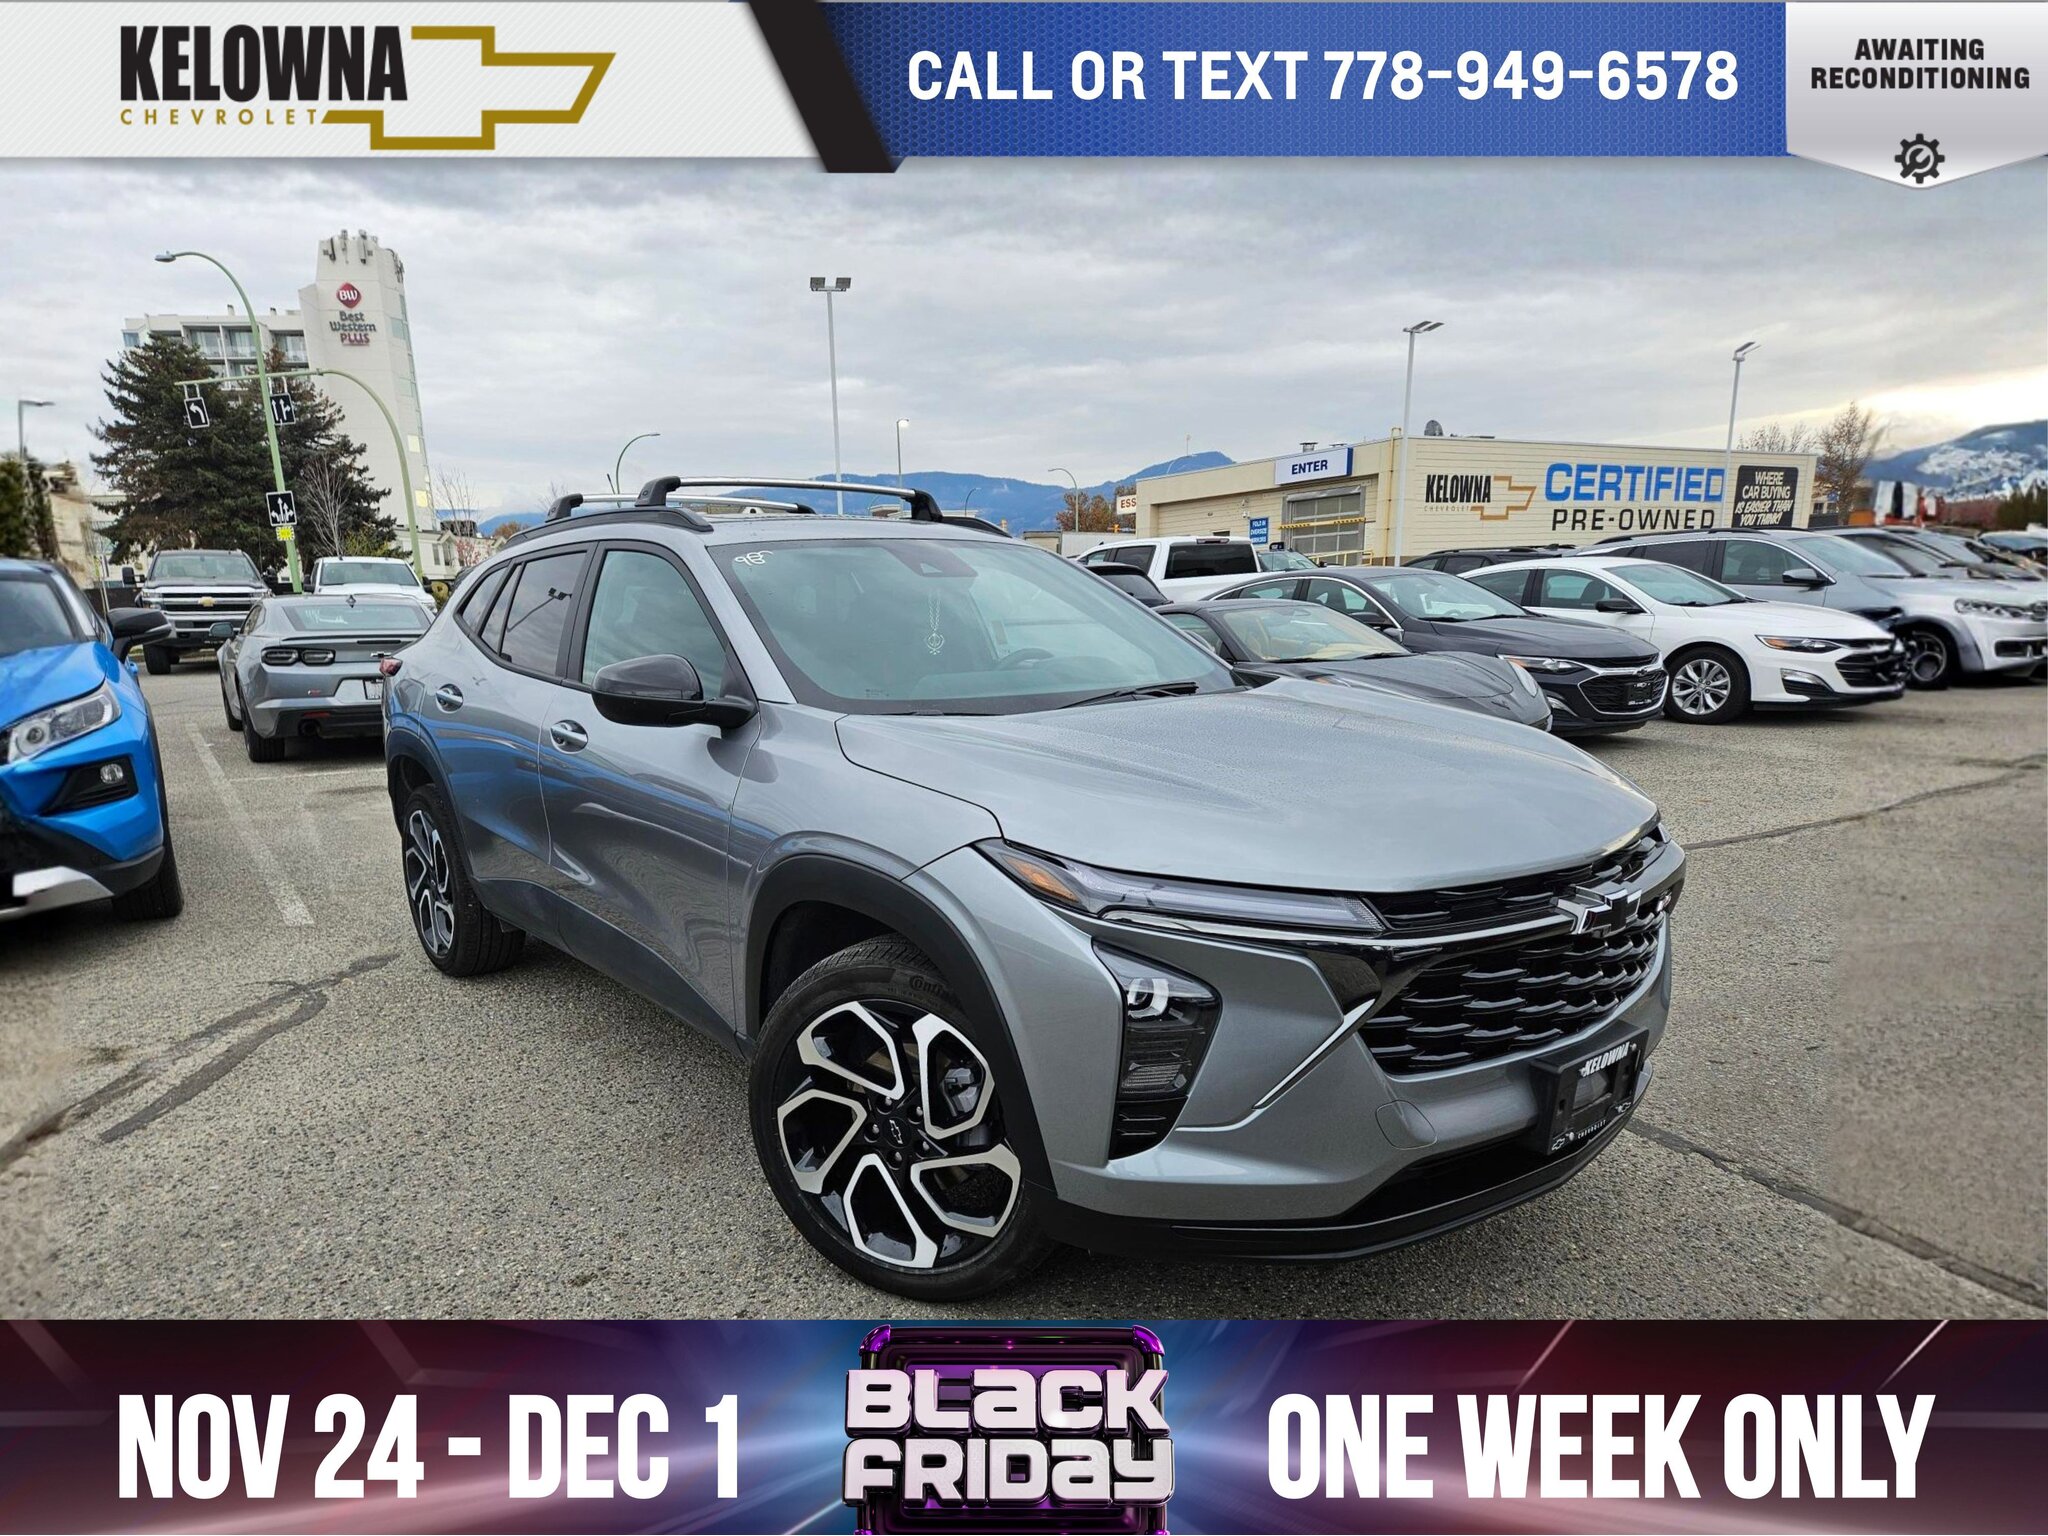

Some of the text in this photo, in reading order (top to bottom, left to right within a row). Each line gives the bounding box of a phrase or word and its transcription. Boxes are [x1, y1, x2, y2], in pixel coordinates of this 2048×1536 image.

[340, 290, 358, 301] BW
[339, 311, 365, 321] Best
[329, 321, 376, 332] Western
[340, 333, 370, 344] PLUS
[1291, 459, 1328, 475] ENTER
[1545, 463, 1725, 502] CERTIFIED
[1755, 471, 1784, 485] WHERE
[1425, 475, 1491, 503] KELOWNA
[1742, 485, 1790, 499] CAR BUYING
[1735, 500, 1793, 514] IS EASIER THAN
[1552, 508, 1715, 532] PRE-OWNED
[1740, 514, 1757, 527] YOU
[1583, 1041, 1631, 1076] KELOWNA
